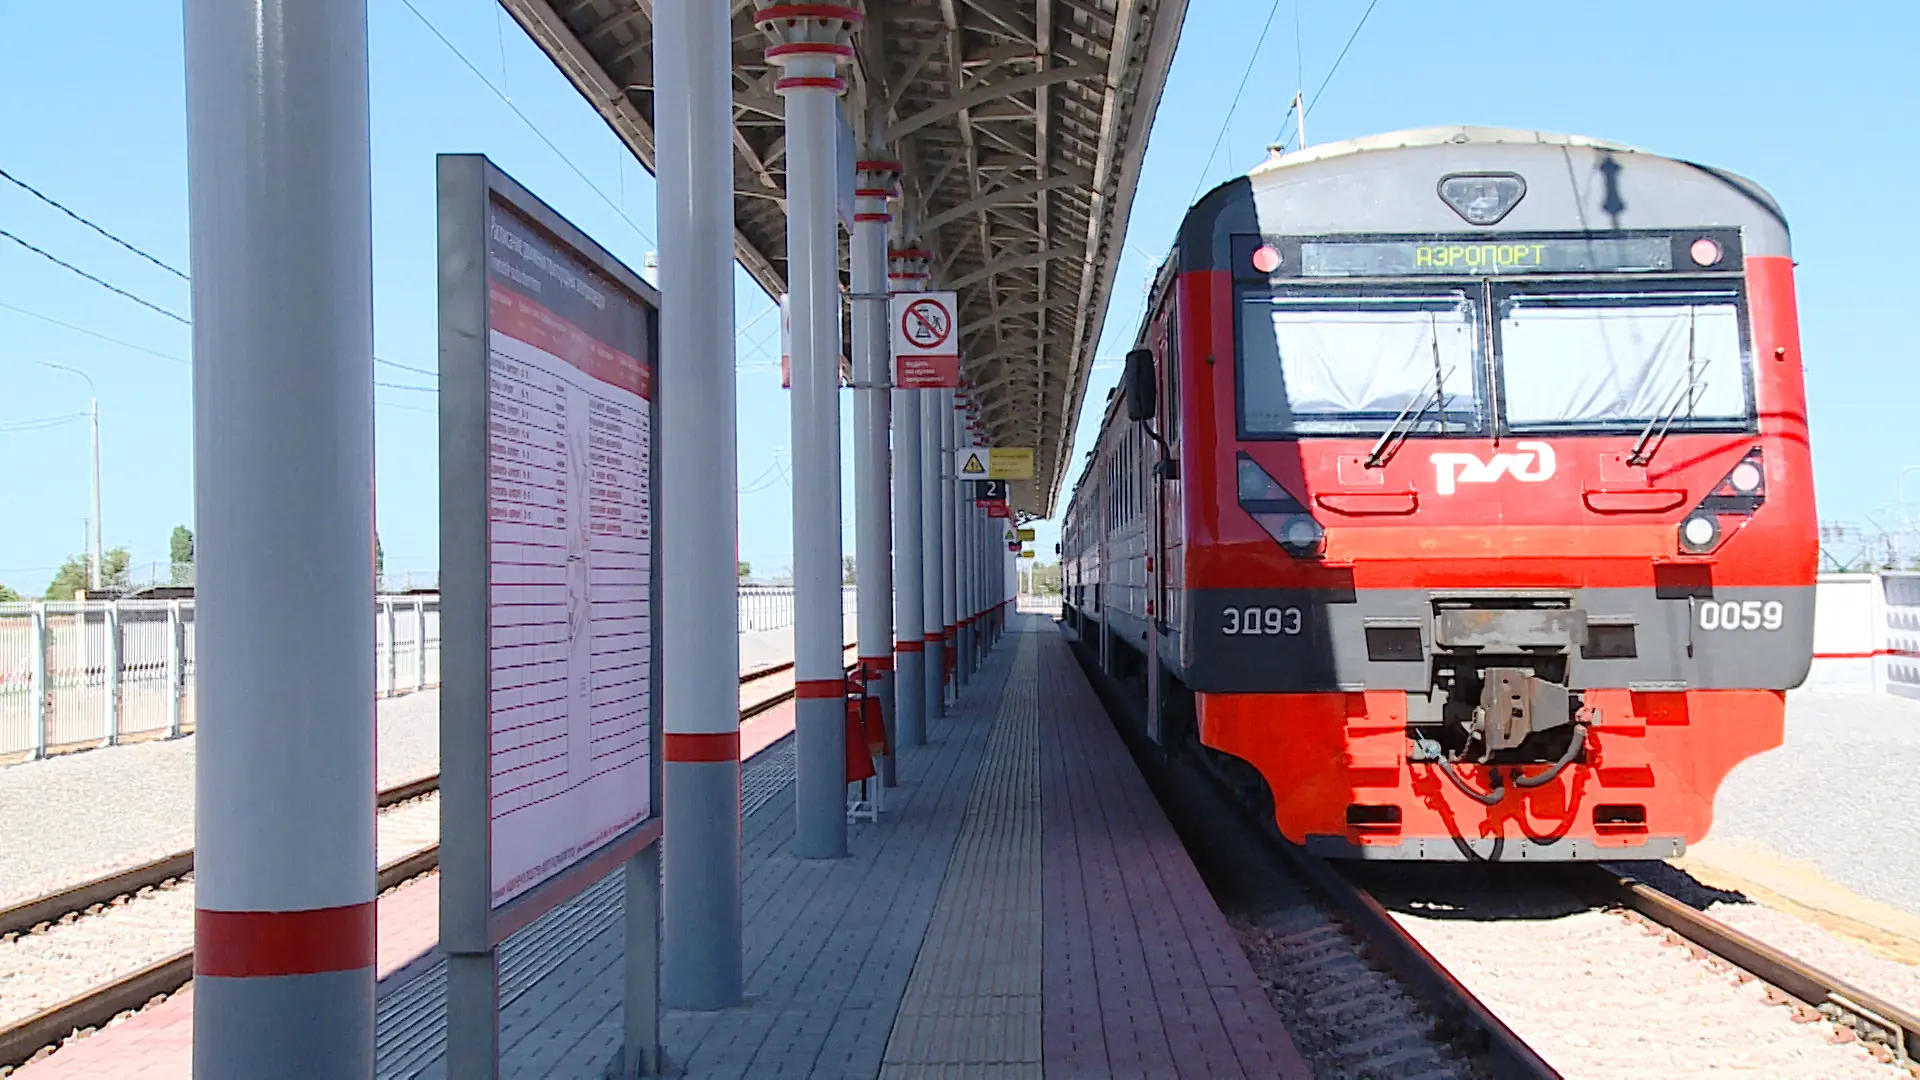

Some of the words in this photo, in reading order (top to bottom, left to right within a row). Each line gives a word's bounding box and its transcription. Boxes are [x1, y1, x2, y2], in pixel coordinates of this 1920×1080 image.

[1416, 244, 1546, 266] АЭРОПОРТ
[986, 481, 997, 496] 2
[1700, 601, 1783, 631] 0059
